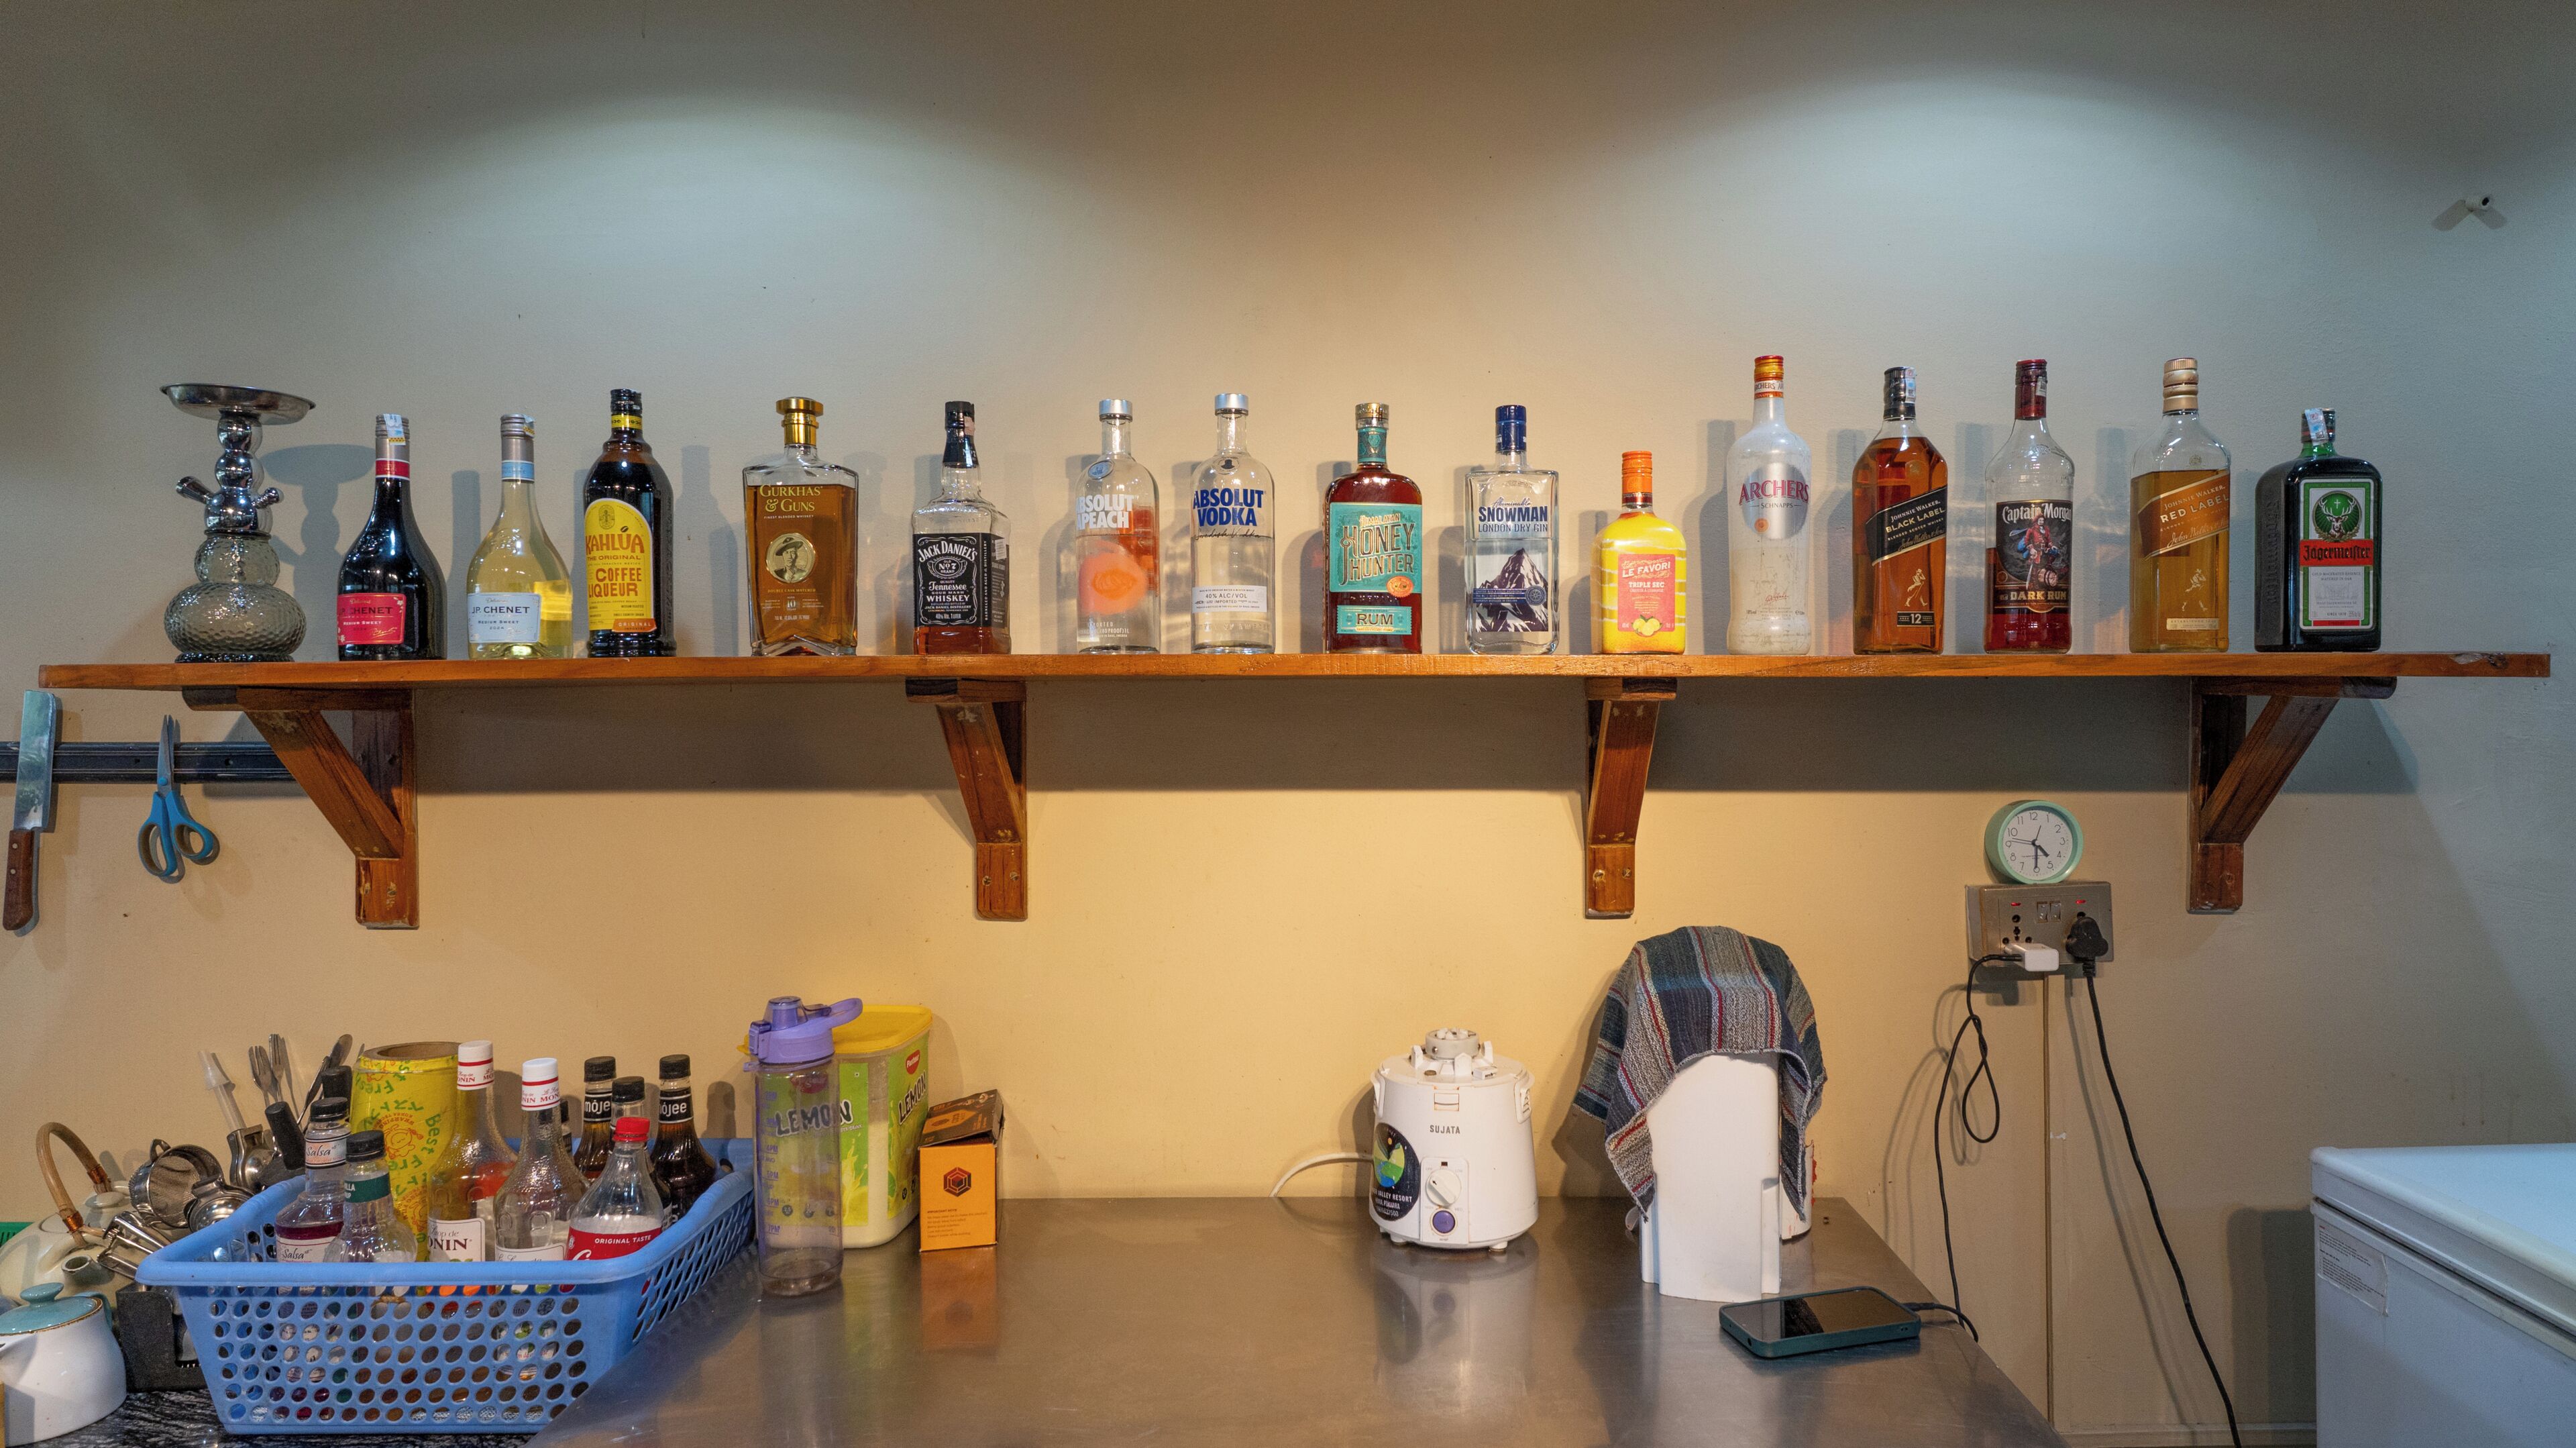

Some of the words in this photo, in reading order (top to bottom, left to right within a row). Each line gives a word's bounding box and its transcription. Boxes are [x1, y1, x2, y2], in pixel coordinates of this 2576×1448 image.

[759, 484, 820, 497] GURKHAS
[1739, 480, 1809, 506] ARCHERS
[1193, 488, 1264, 509] ABSOLUT
[765, 499, 778, 512] &
[780, 499, 815, 512] GUNS
[2160, 509, 2186, 523] RED
[2190, 494, 2230, 513] LABEL
[1197, 507, 1257, 527] VODKA
[1479, 506, 1548, 522] SNOWMAN
[1886, 517, 1915, 533] BLACK
[1917, 507, 1945, 521] LABEL
[1891, 509, 1916, 523] JOHNNIE
[2002, 504, 2041, 524] Captain
[1479, 523, 1511, 532] LONDON
[1515, 523, 1530, 532] DRY
[1534, 523, 1548, 532] GIN
[1340, 523, 1415, 560] HONEY
[918, 544, 941, 562] JACK
[941, 540, 978, 562] DANIEL'S
[1349, 554, 1414, 581] HUNTER
[1622, 568, 1635, 578] LE
[1637, 562, 1671, 574] FAVORI
[596, 568, 642, 582] COFFEE
[588, 582, 638, 598] LIQUEUR
[928, 581, 967, 591] Tennessee
[926, 594, 970, 603] WHISKEY
[2010, 591, 2045, 601] DARK
[2047, 591, 2067, 600] RUM
[787, 599, 796, 608] 10
[349, 607, 393, 615] CHENET
[484, 606, 530, 614] CHENET
[1356, 613, 1395, 626] RUM
[1910, 613, 1922, 624] 12
[2017, 816, 2024, 825] 11
[2029, 812, 2038, 821] 12
[2047, 815, 2050, 823] 1
[2007, 827, 2018, 837] 10
[2054, 824, 2061, 833] 2
[2005, 840, 2012, 848] 9
[2010, 853, 2016, 861] 8
[2020, 862, 2025, 871] 7
[2047, 861, 2053, 869] 5
[898, 1070, 926, 1125] LEMON
[774, 1099, 854, 1138] LEMON
[1430, 1125, 1460, 1134] SUJATA
[306, 1145, 332, 1157] Salsa
[389, 1155, 423, 1172] Fre
[1392, 1194, 1413, 1202] RESORT
[633, 1235, 651, 1243] TASTE
[282, 1247, 305, 1260] Salsa
